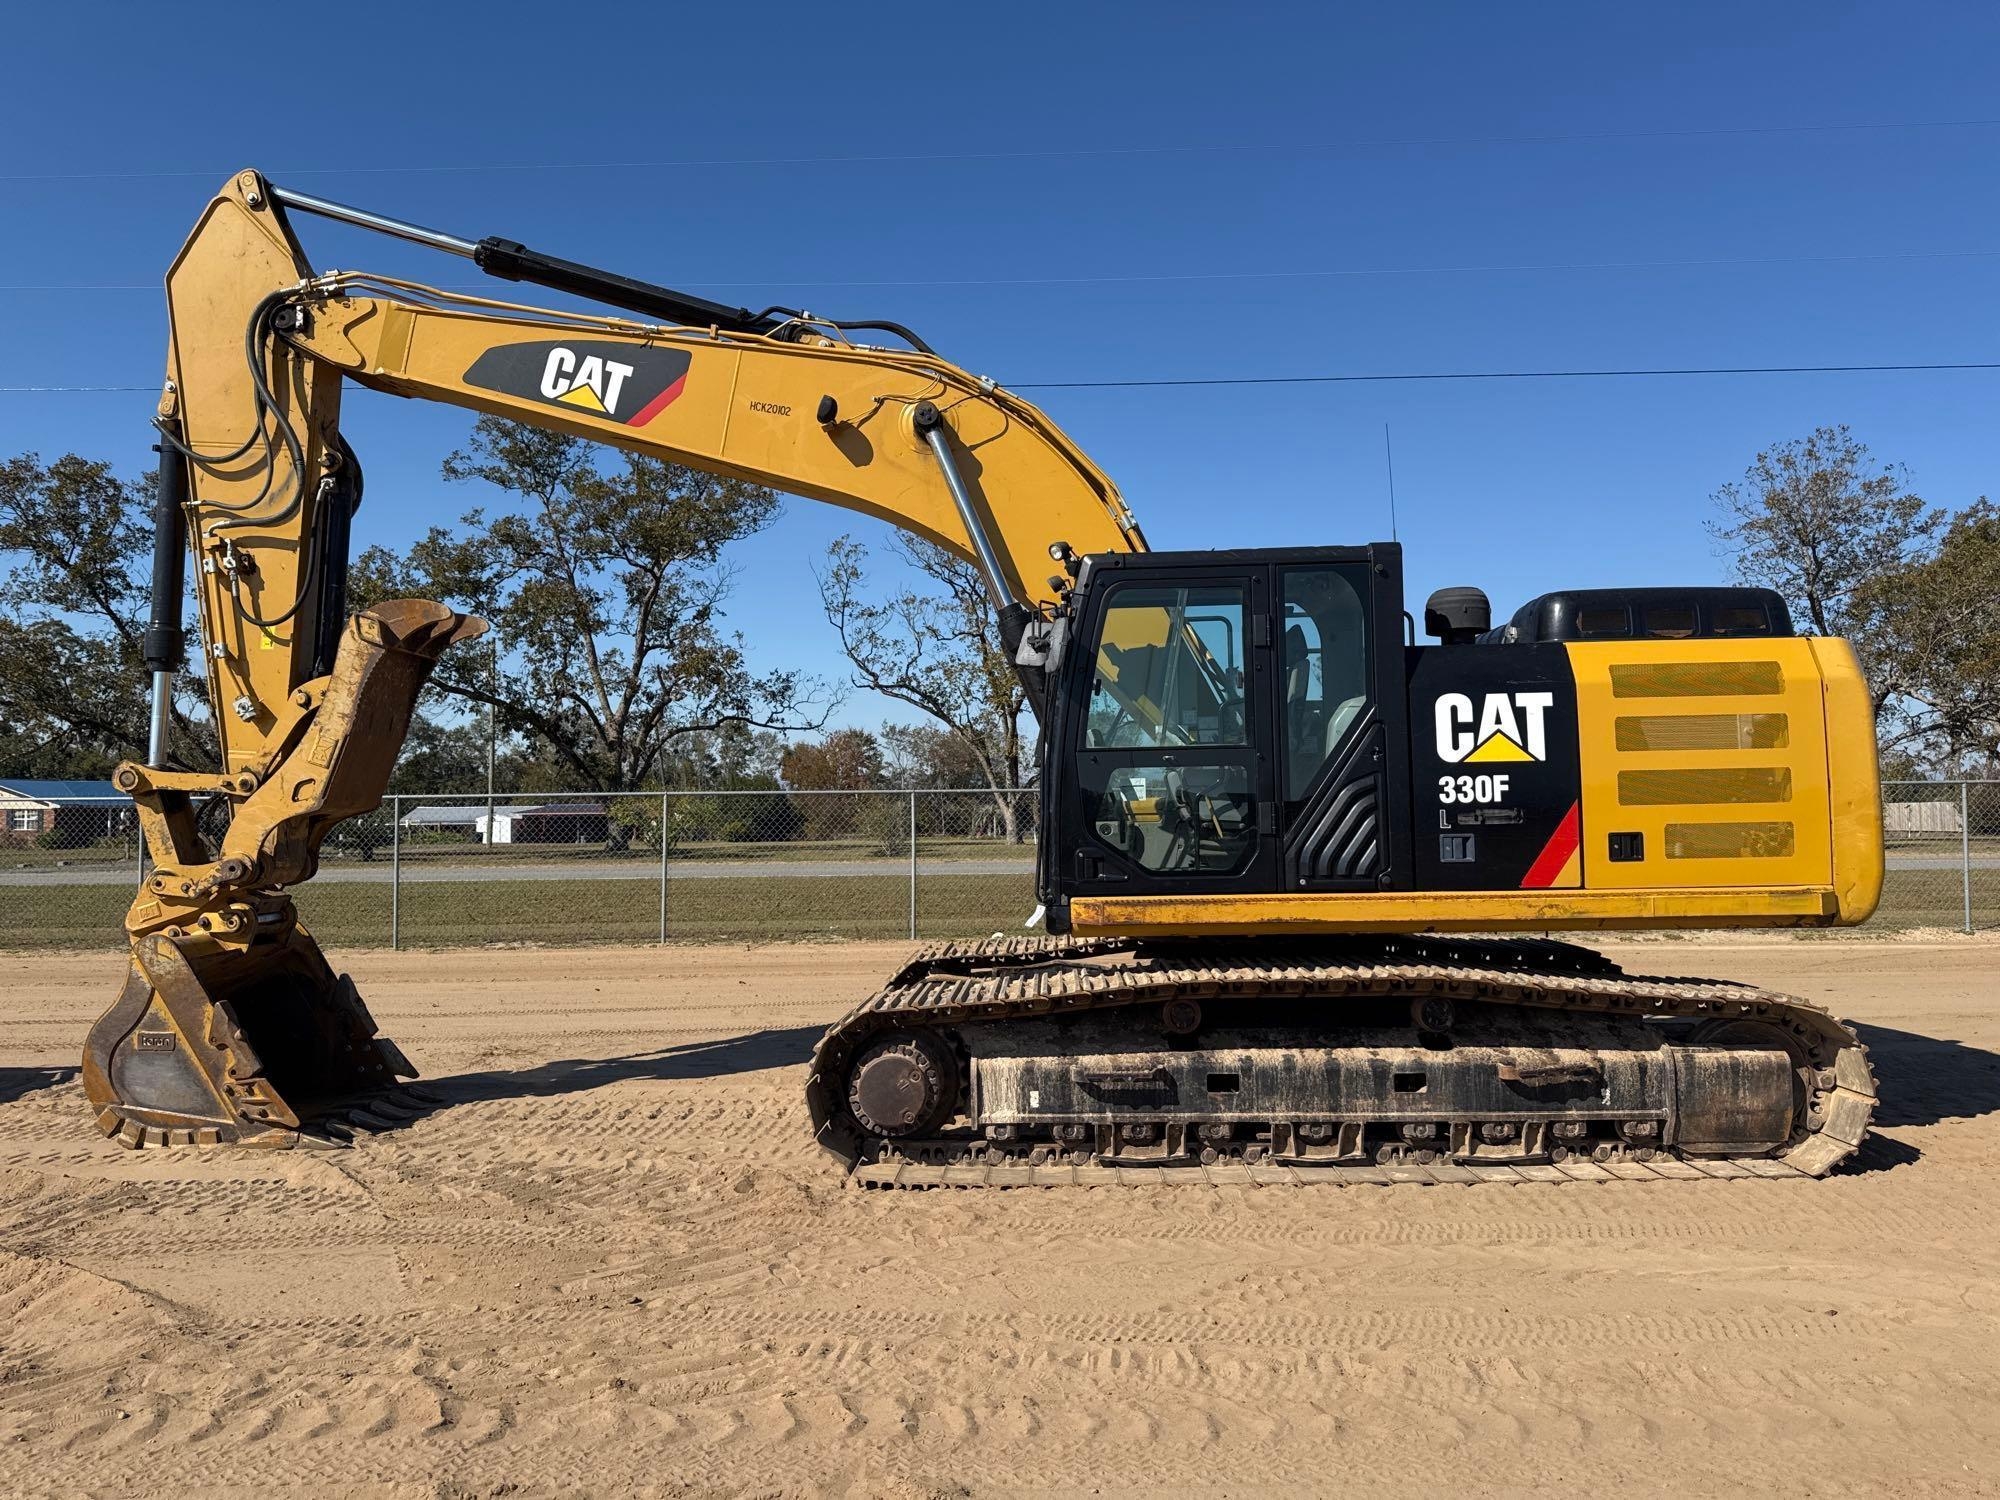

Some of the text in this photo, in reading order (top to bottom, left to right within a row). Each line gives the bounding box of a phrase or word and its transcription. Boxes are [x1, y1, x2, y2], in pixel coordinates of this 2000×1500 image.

[540, 347, 634, 415] CAT
[749, 401, 792, 416] HCK20102
[1435, 692, 1553, 763] CAT
[1438, 775, 1510, 804] 330F
[1439, 809, 1452, 829] L
